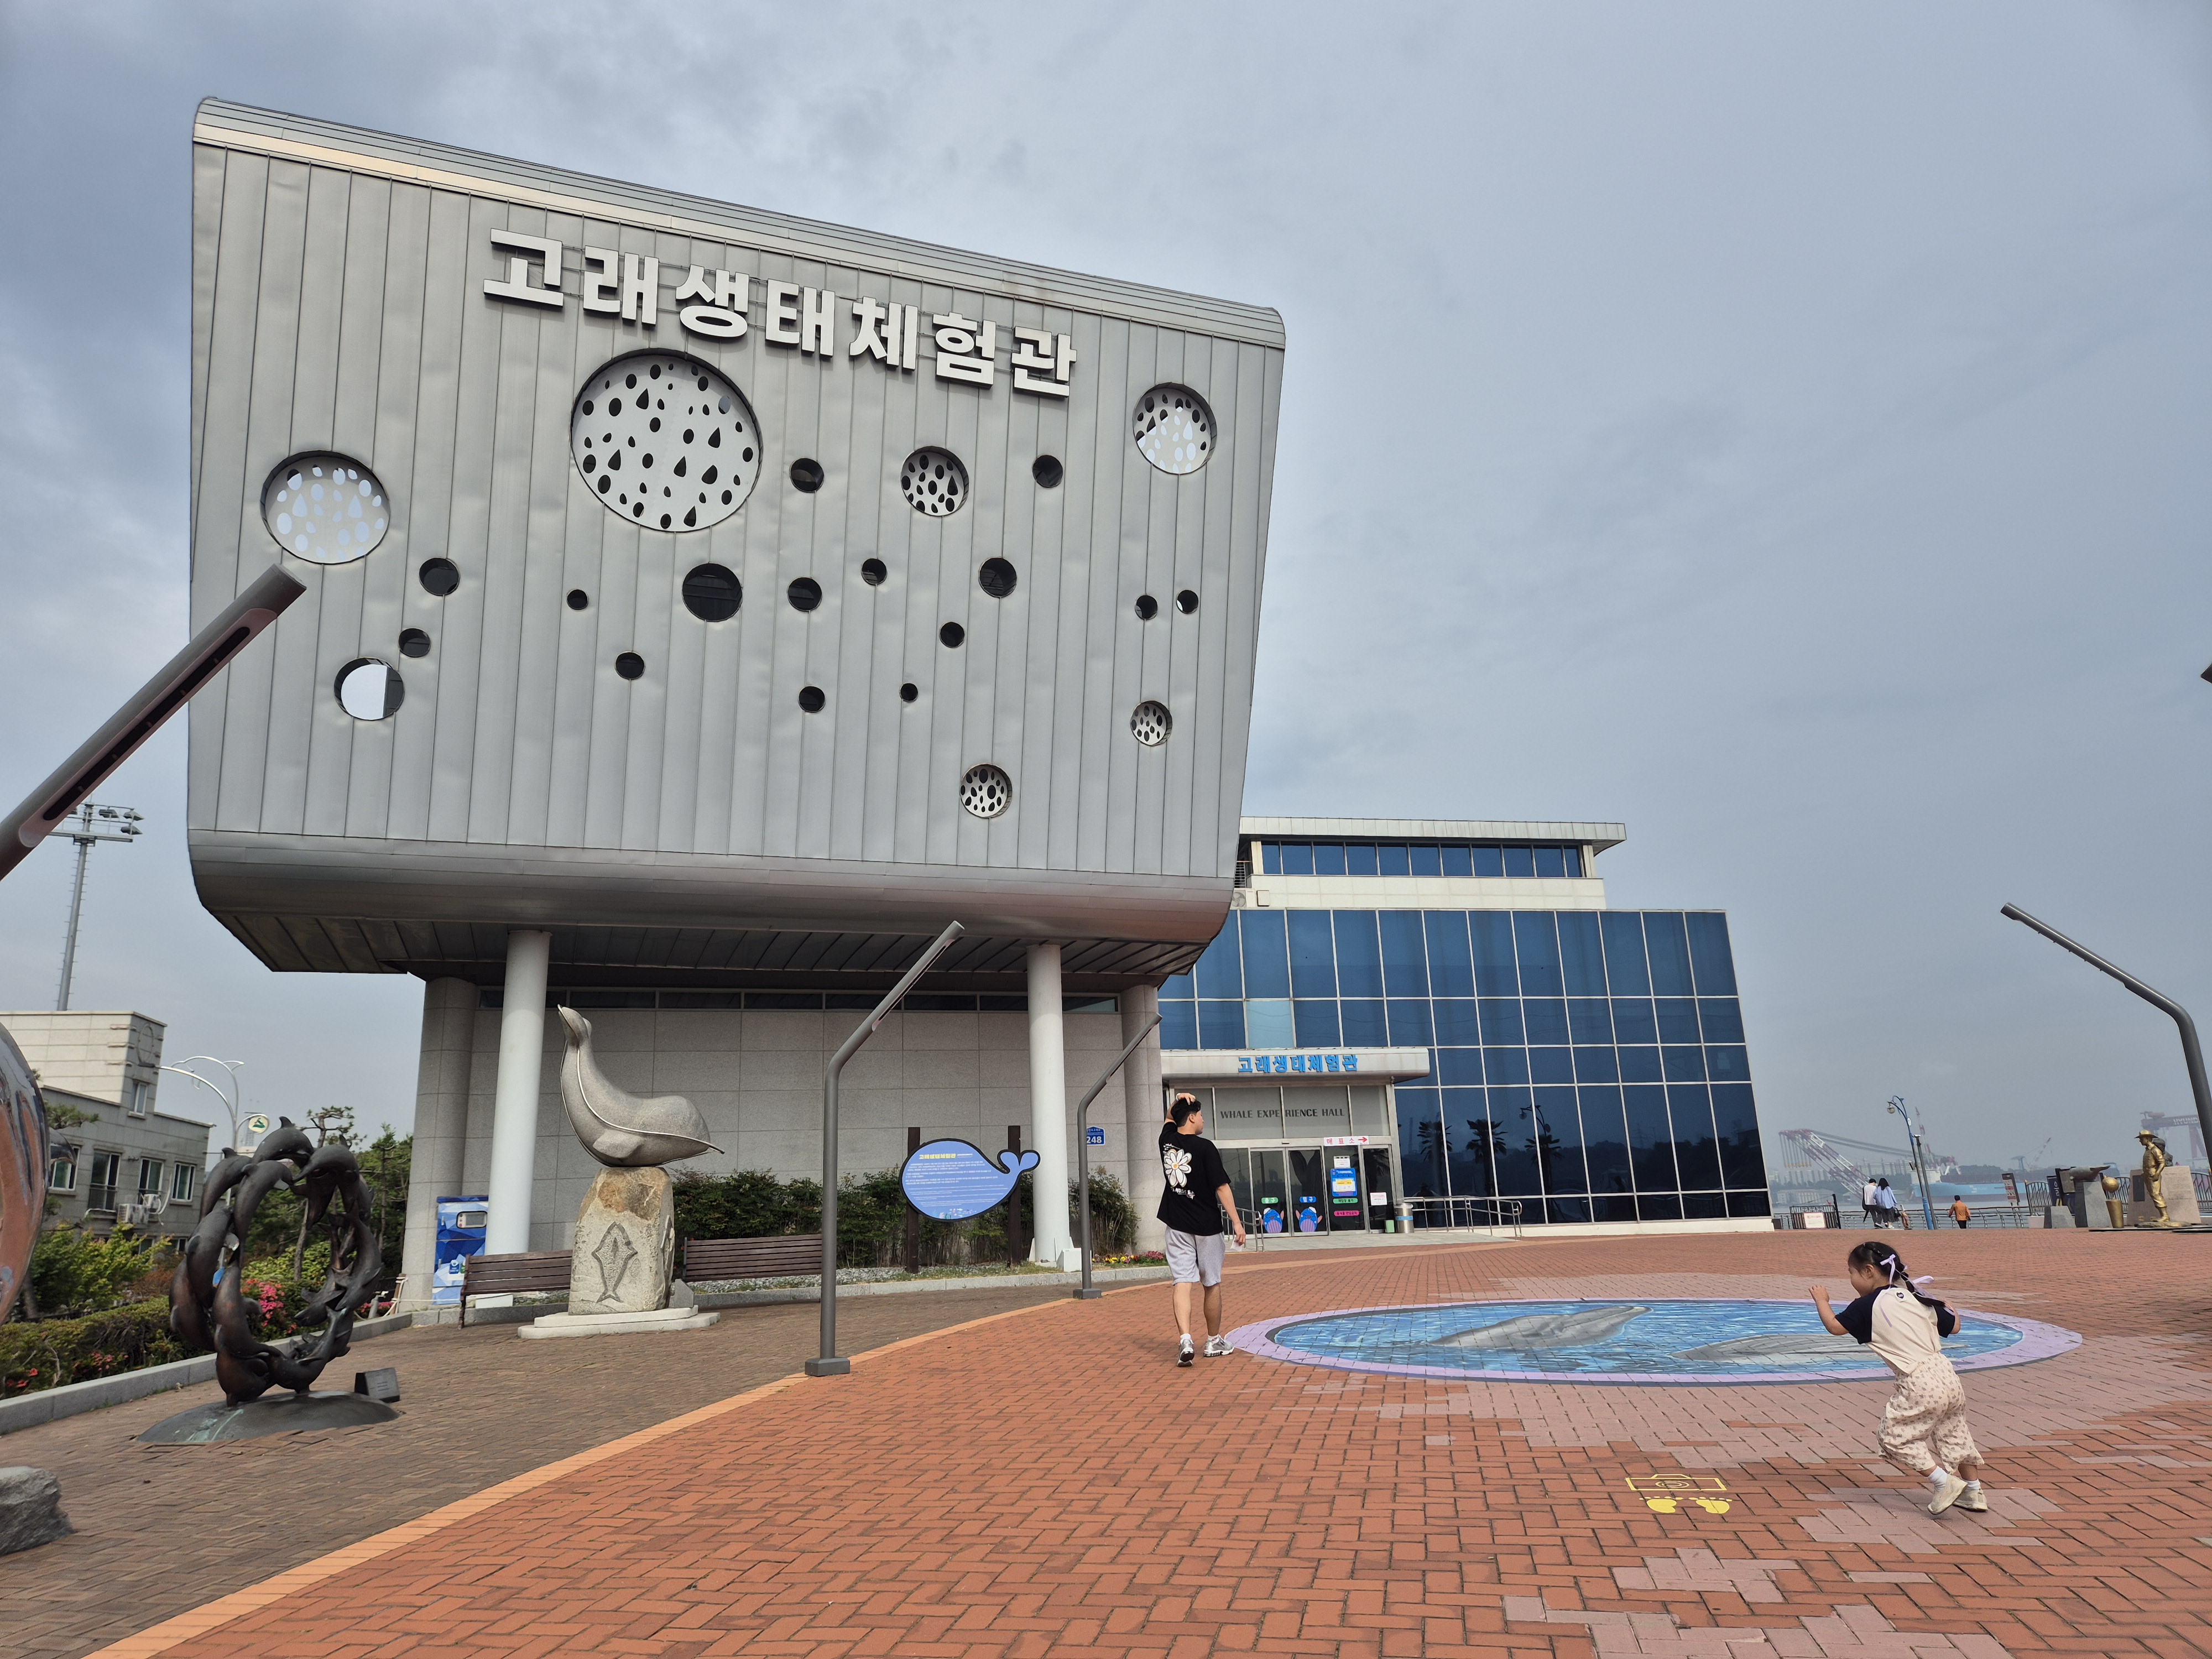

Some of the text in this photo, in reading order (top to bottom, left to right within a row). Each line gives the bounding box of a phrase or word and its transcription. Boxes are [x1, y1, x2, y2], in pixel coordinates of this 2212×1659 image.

[483, 228, 1077, 398] 고래생태체험관
[1238, 1055, 1358, 1073] 고래생태체험관
[1220, 1108, 1345, 1119] WHALE EXPERIENCE HALL
